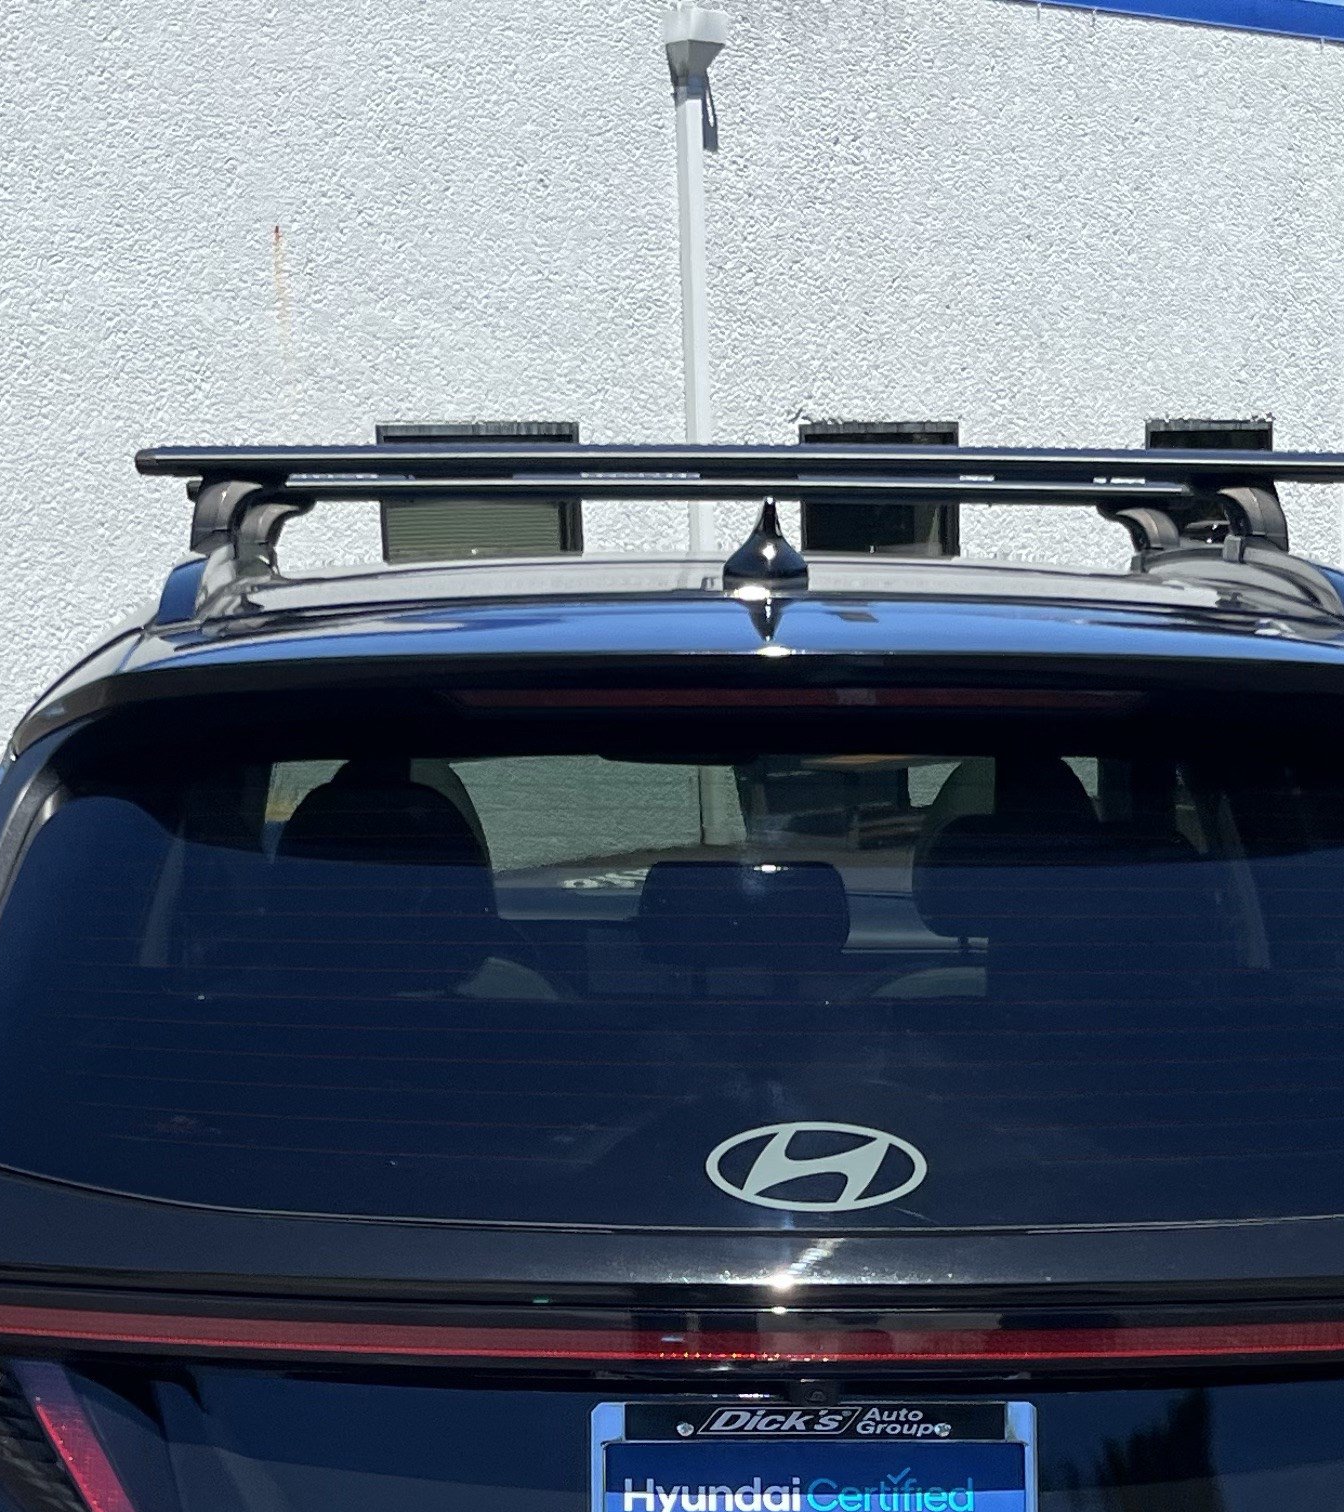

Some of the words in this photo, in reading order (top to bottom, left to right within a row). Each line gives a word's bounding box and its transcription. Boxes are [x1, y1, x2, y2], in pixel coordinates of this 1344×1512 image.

[709, 1409, 844, 1431] Dick's
[862, 1407, 924, 1421] Auto
[856, 1420, 935, 1437] Group
[806, 1467, 975, 1512] Certified
